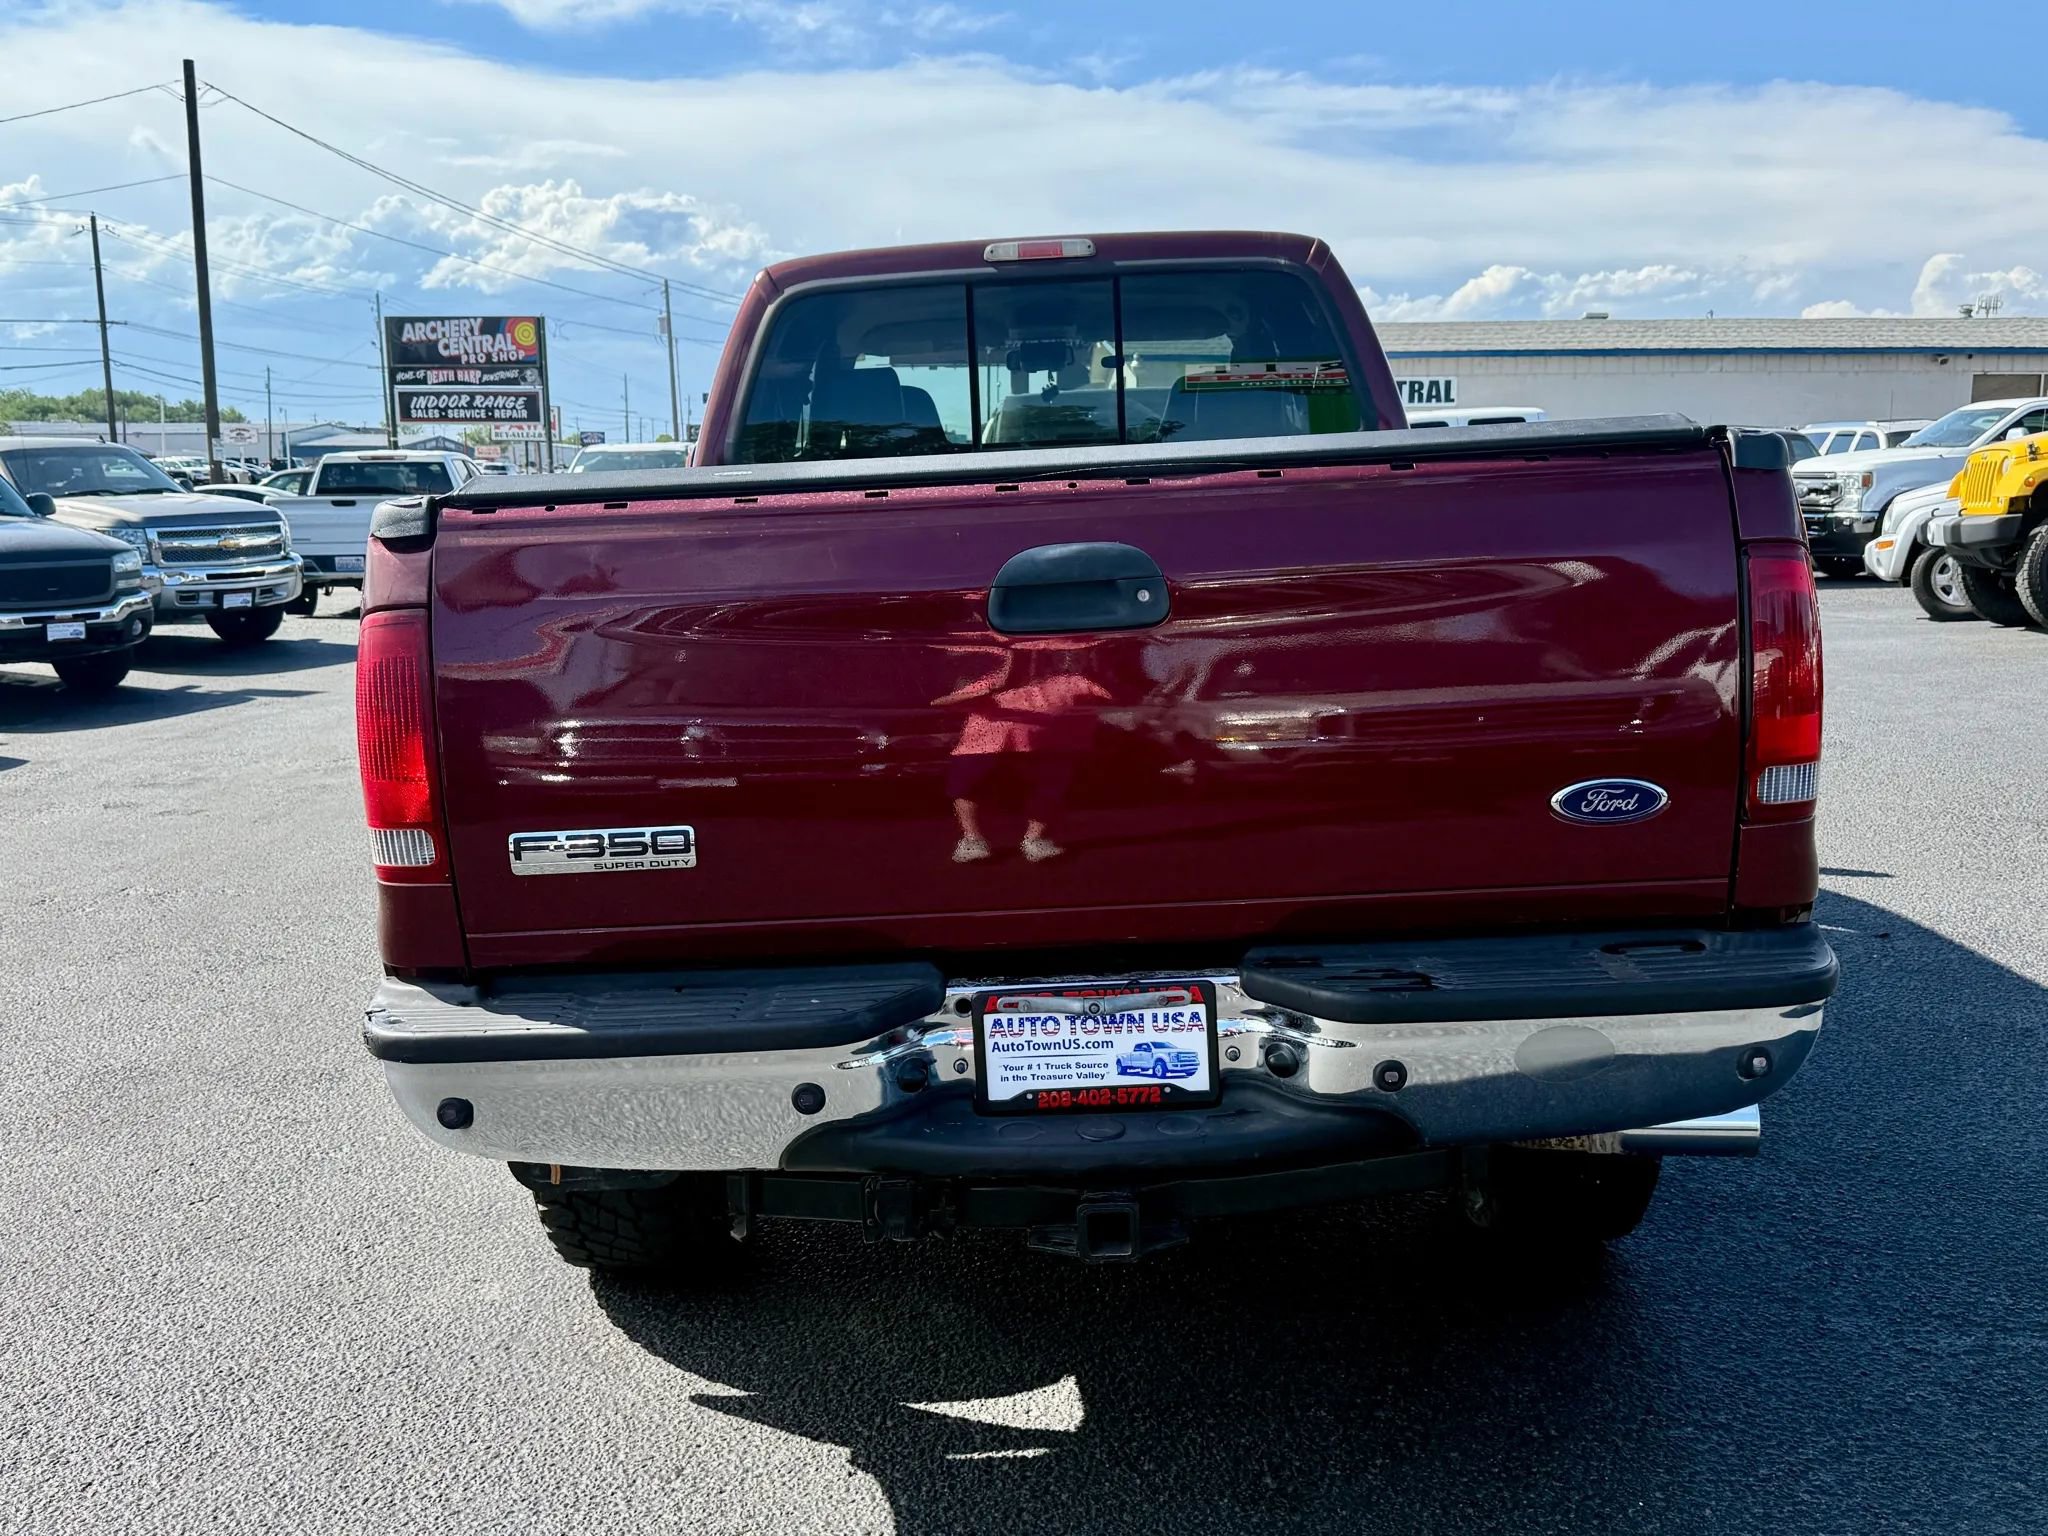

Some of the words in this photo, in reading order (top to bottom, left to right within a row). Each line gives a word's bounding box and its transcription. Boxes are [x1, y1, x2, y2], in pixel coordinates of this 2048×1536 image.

[402, 318, 482, 343] ARCHERY
[438, 333, 516, 357] CENTRAL
[461, 352, 486, 365] PRO
[491, 350, 525, 363] SHOP
[426, 370, 455, 385] DEATH
[410, 395, 471, 409] INDOOR
[473, 396, 527, 410] RANGE
[411, 409, 440, 419] SALES
[447, 408, 487, 419] SERVICE
[494, 408, 528, 419] REPAIR
[1581, 788, 1640, 812] Ford
[513, 829, 692, 862] F-350
[594, 862, 645, 870] SUPER
[650, 858, 691, 868] DUTY
[989, 1015, 1061, 1039] AUTO
[1064, 1013, 1145, 1036] TOWN
[1152, 1011, 1205, 1034] USA
[991, 1038, 1114, 1053] AutoTownUS.com
[1044, 1062, 1073, 1070] Truck
[1075, 1061, 1109, 1069] Source
[1000, 1075, 1009, 1083] in
[1012, 1074, 1028, 1082] the
[1030, 1073, 1073, 1082] Treasure
[1038, 1087, 1161, 1109] 208-402-5772
